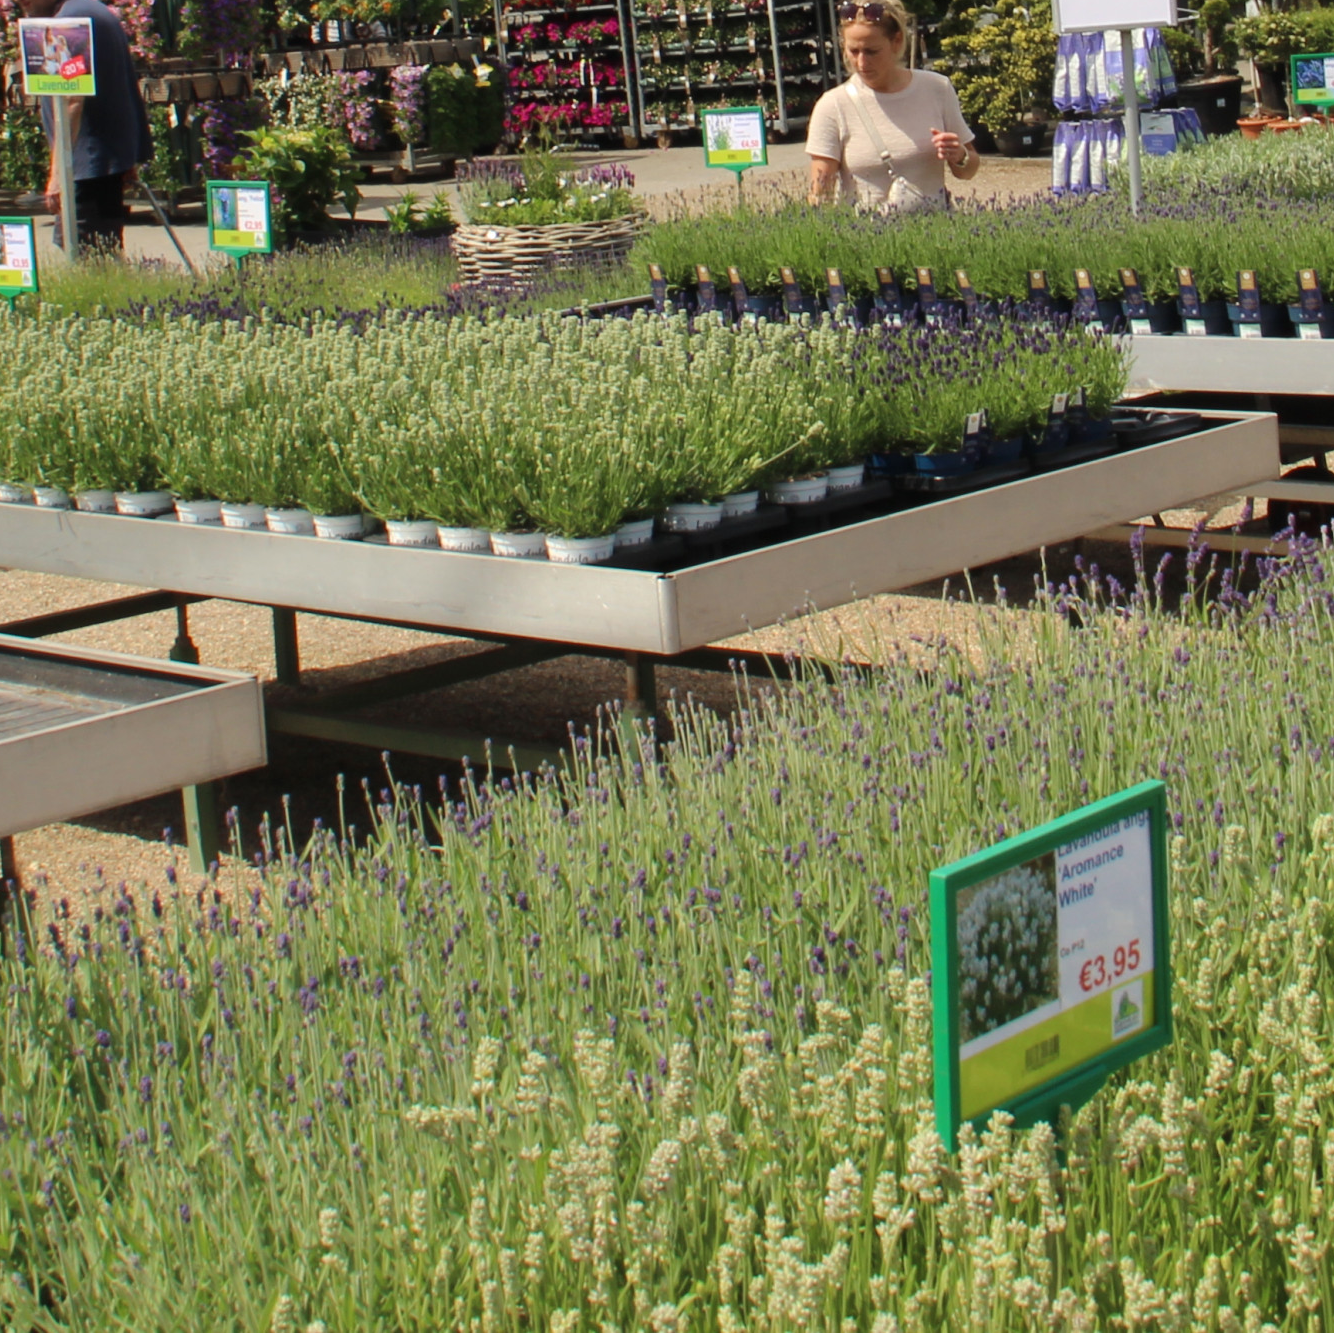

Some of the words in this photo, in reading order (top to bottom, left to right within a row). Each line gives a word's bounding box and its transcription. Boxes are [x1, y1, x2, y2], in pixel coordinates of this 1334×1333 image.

[37, 78, 80, 91] Lavendel
[1058, 876, 1098, 909] White'
[1078, 939, 1141, 992] €3,95
